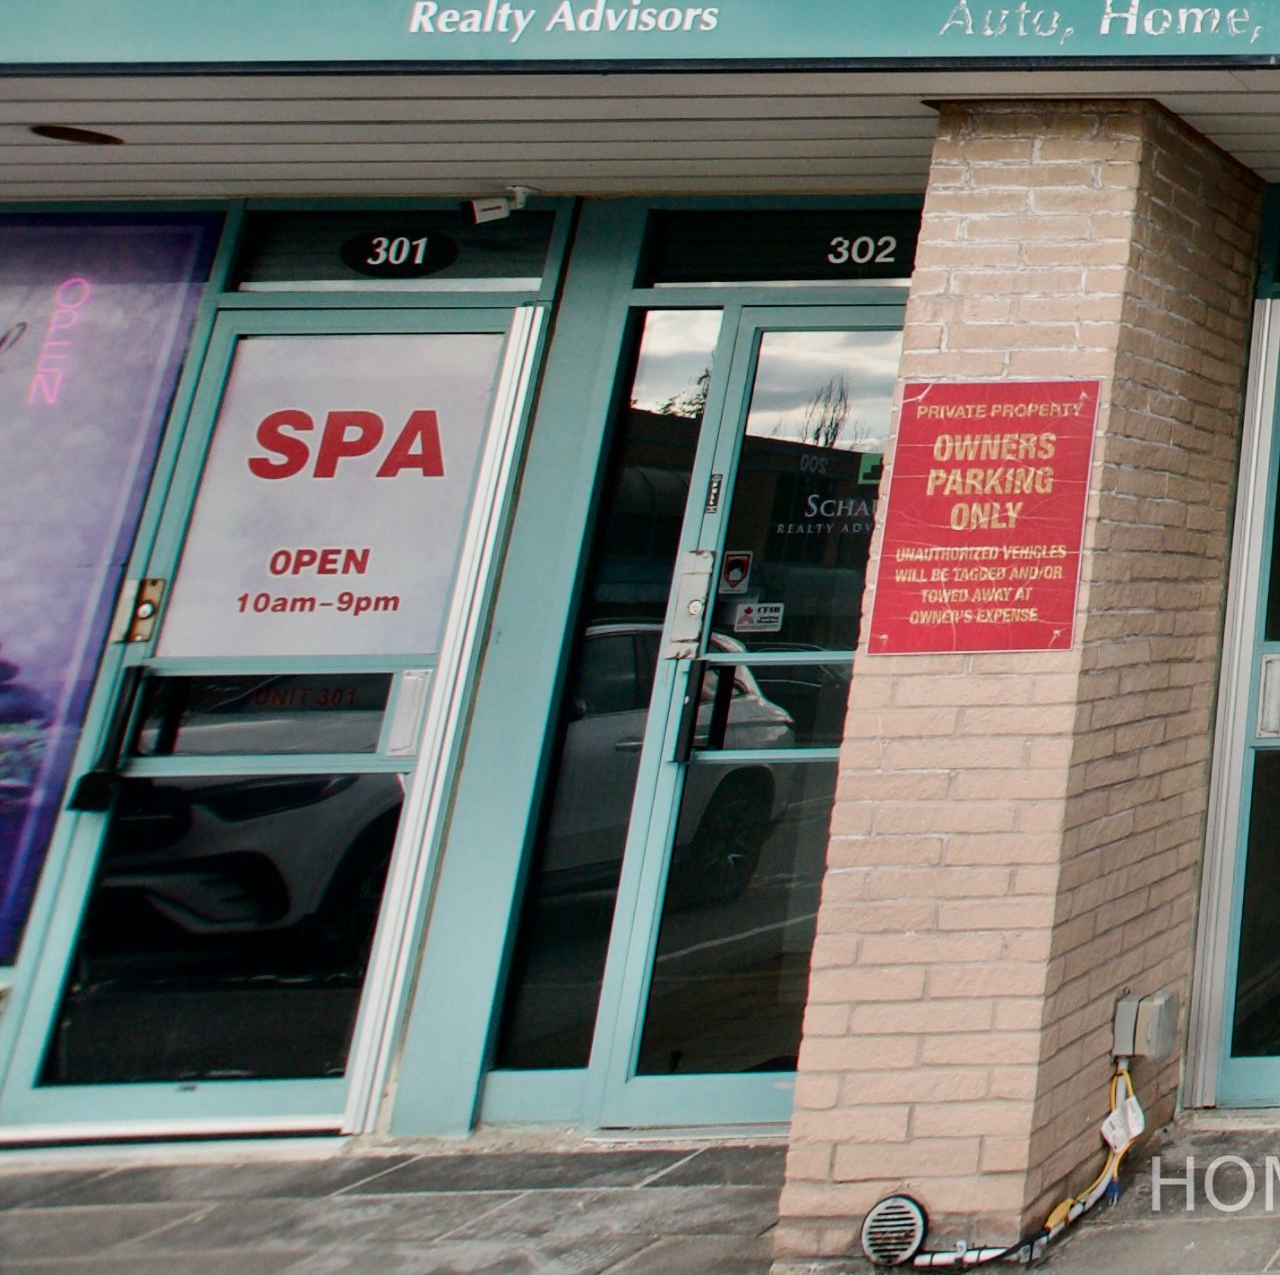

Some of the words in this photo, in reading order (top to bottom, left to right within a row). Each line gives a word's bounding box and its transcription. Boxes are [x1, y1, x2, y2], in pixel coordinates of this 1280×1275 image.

[366, 236, 429, 266] 301
[827, 236, 897, 265] 302
[25, 276, 91, 407] OPEN
[917, 405, 986, 419] PRIVATE
[990, 403, 1083, 418] PROPERTY
[247, 409, 445, 481] SPA
[933, 432, 1057, 462] OWNERS
[926, 466, 1054, 496] PARKING
[776, 524, 834, 534] REALTY
[950, 501, 1023, 531] ONLY
[269, 548, 370, 576] OPEN
[896, 547, 999, 562] UNAUTHORIZED
[1002, 544, 1067, 559] VEHICLES
[895, 568, 926, 582] WILL
[930, 567, 949, 582] BE
[953, 567, 1006, 581] TAGGED
[1008, 565, 1063, 580] AND/OR
[236, 591, 400, 616] 10am-9pm
[921, 588, 969, 602] TOWED
[971, 587, 1012, 601] AWAY
[1014, 587, 1033, 600] AT
[909, 609, 973, 624] OWNER'S
[976, 608, 1039, 622] EXPENSE
[251, 687, 312, 708] UNIT
[317, 687, 356, 708] 301
